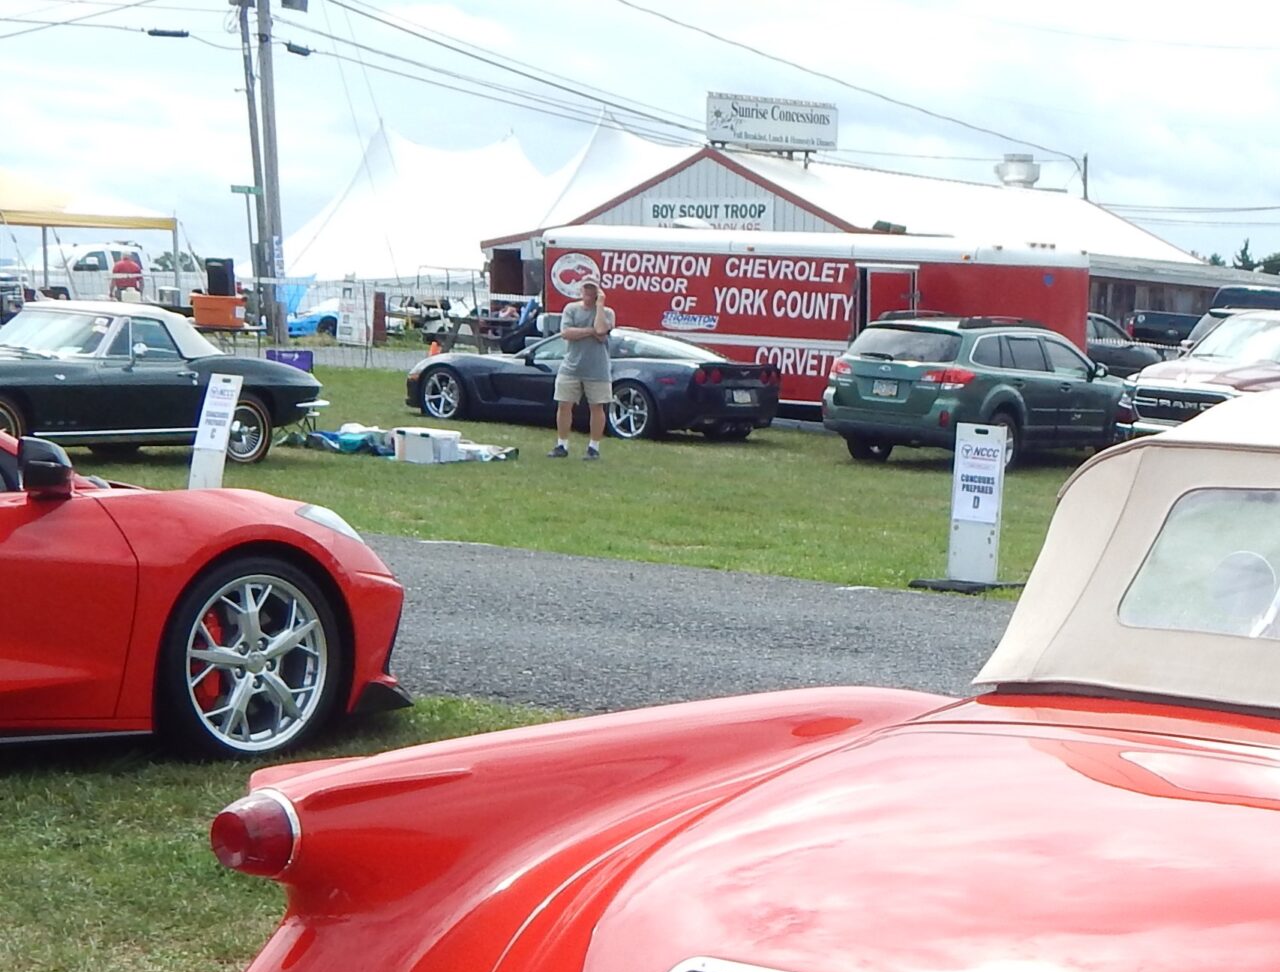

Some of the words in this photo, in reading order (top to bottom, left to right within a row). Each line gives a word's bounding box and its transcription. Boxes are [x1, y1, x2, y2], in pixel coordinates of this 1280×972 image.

[731, 101, 768, 119] Sunrise
[771, 105, 830, 125] Concessions
[652, 204, 675, 218] BOY
[678, 204, 719, 218] SCOUT
[724, 204, 766, 219] TROOP
[601, 252, 711, 277] THORNTON
[725, 258, 849, 283] CHEVROLET
[601, 275, 688, 293] SPONSOR
[671, 296, 698, 312] OF
[714, 286, 768, 316] YORK
[772, 291, 855, 321] COUNTY
[1159, 399, 1198, 409] RAM
[973, 447, 999, 458] NCCC
[961, 473, 995, 485] CONCOURS
[962, 483, 994, 495] PREPARED
[973, 496, 980, 509] D
